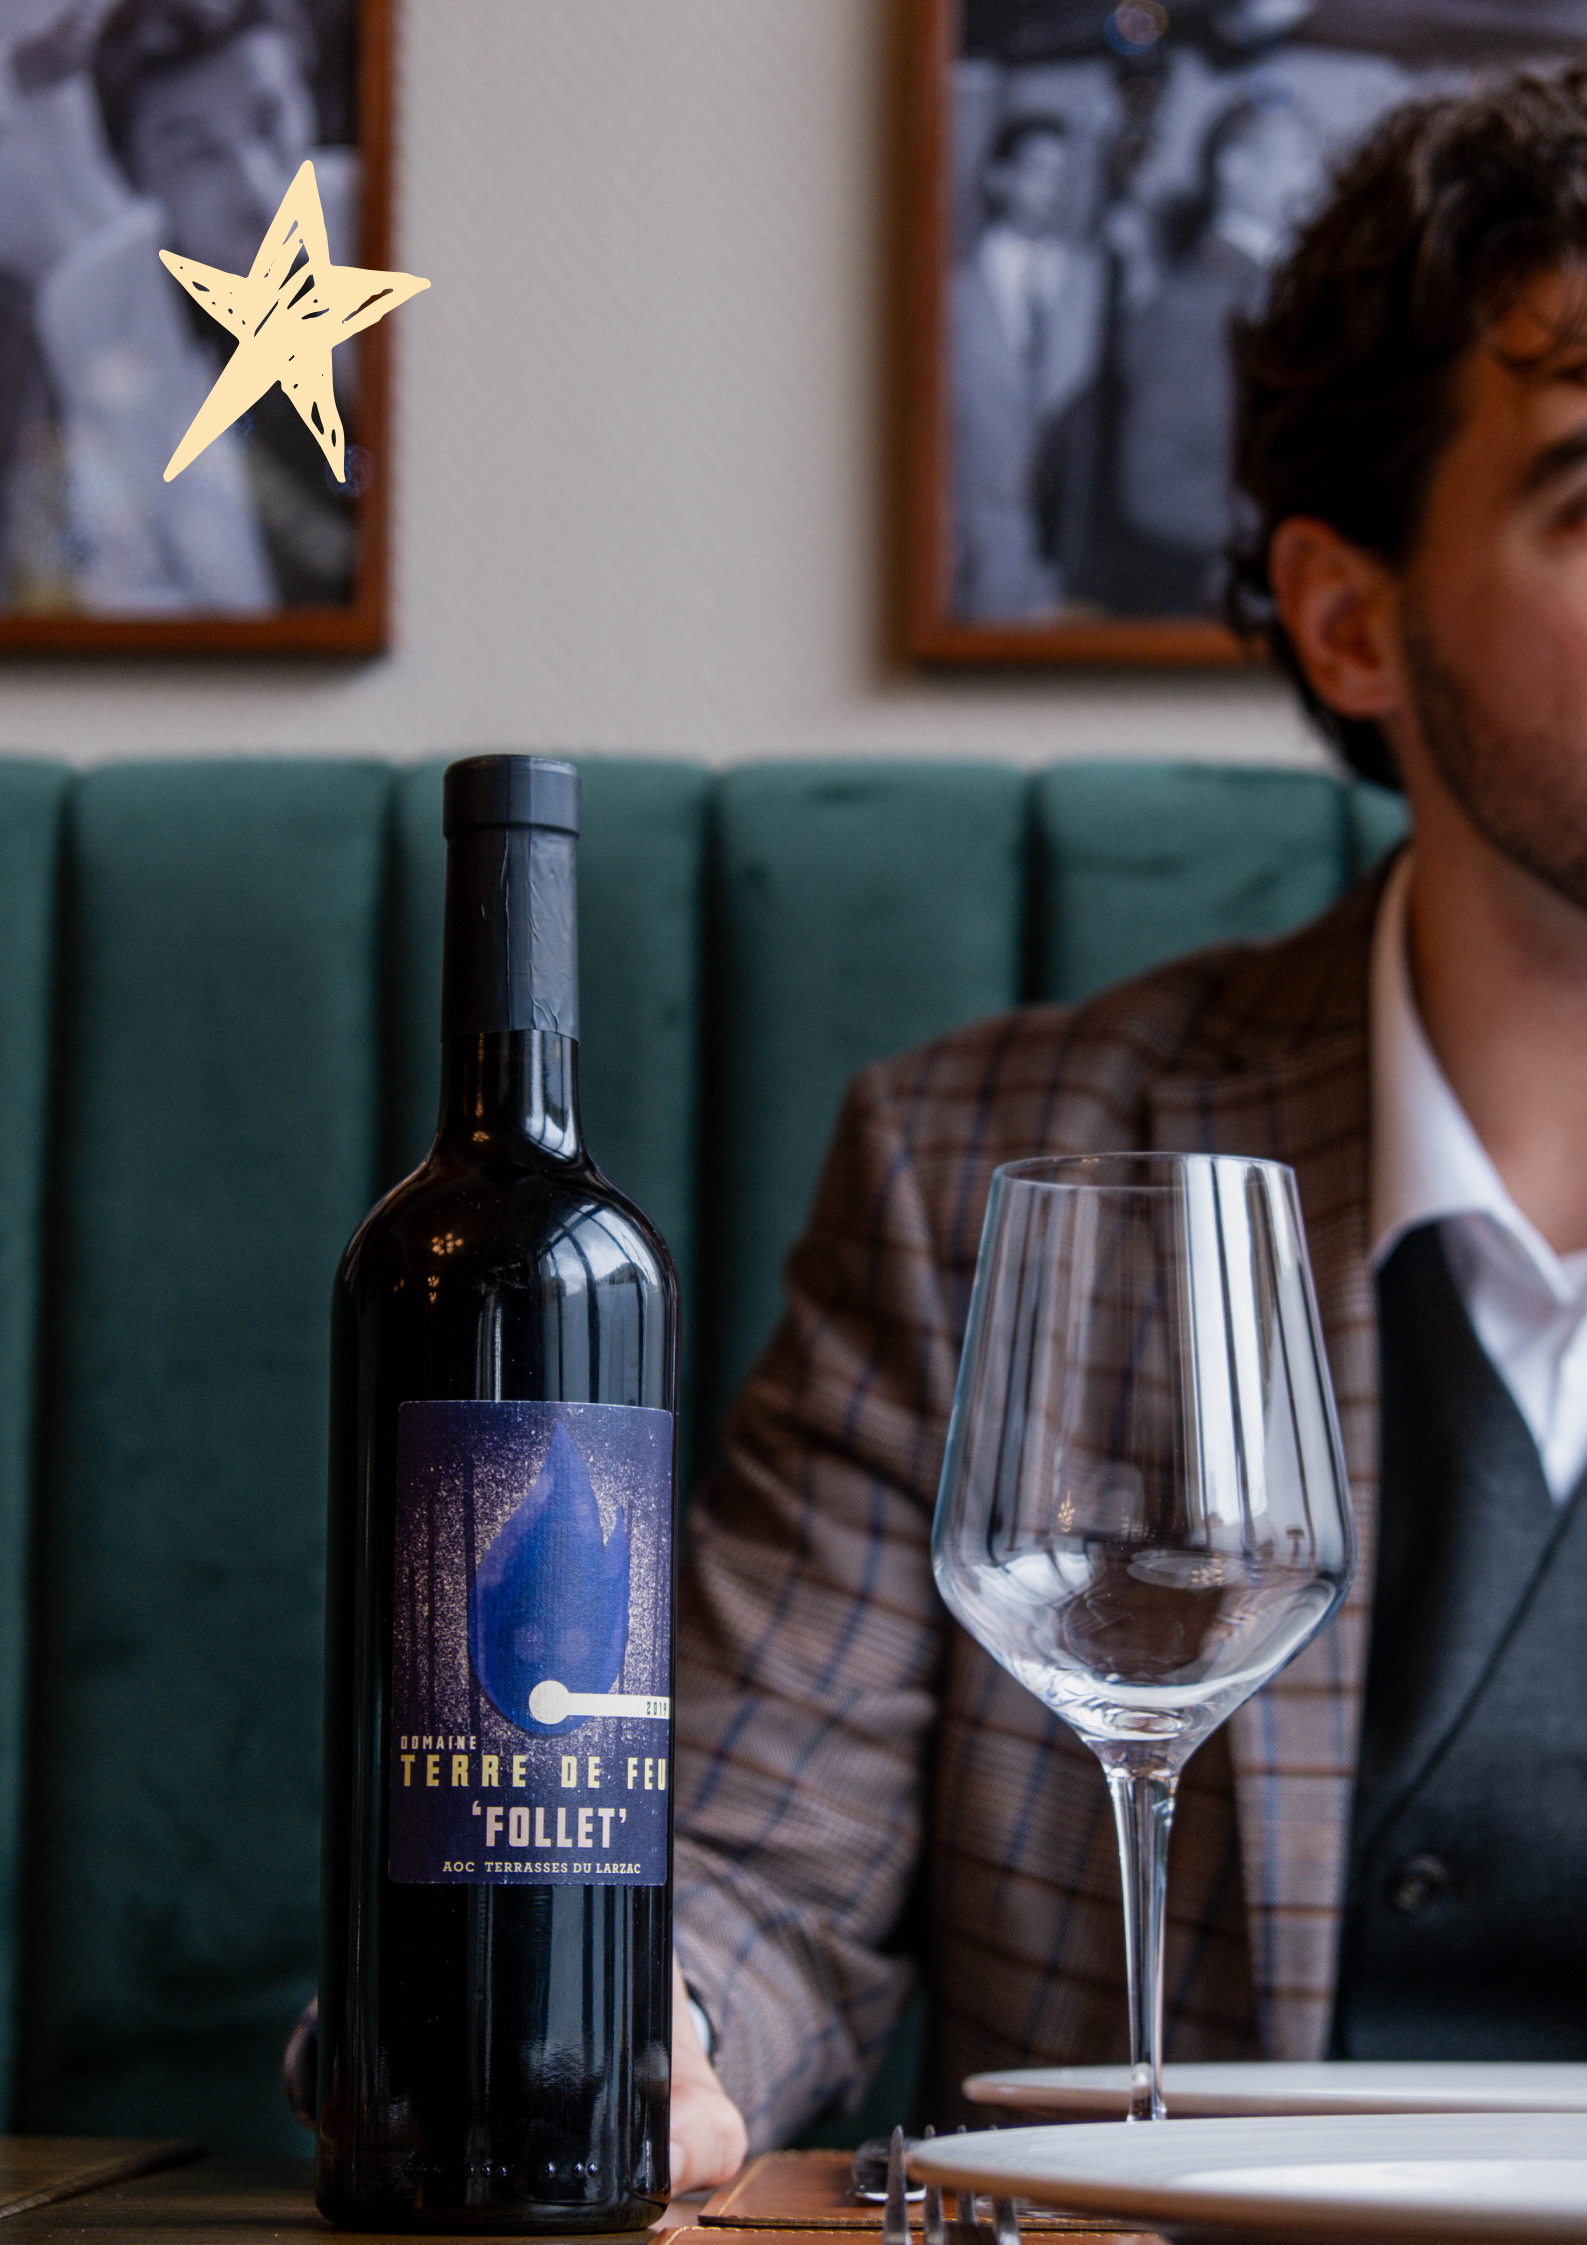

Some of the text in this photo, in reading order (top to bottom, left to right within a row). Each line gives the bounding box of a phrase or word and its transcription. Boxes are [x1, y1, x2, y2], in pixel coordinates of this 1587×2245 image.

[646, 1701, 667, 1716] 2019
[400, 1735, 477, 1750] DOMAINE
[400, 1754, 666, 1790] TERRE DE FEU
[442, 1861, 642, 1875] AOC TERRASSES DU LARZAC
